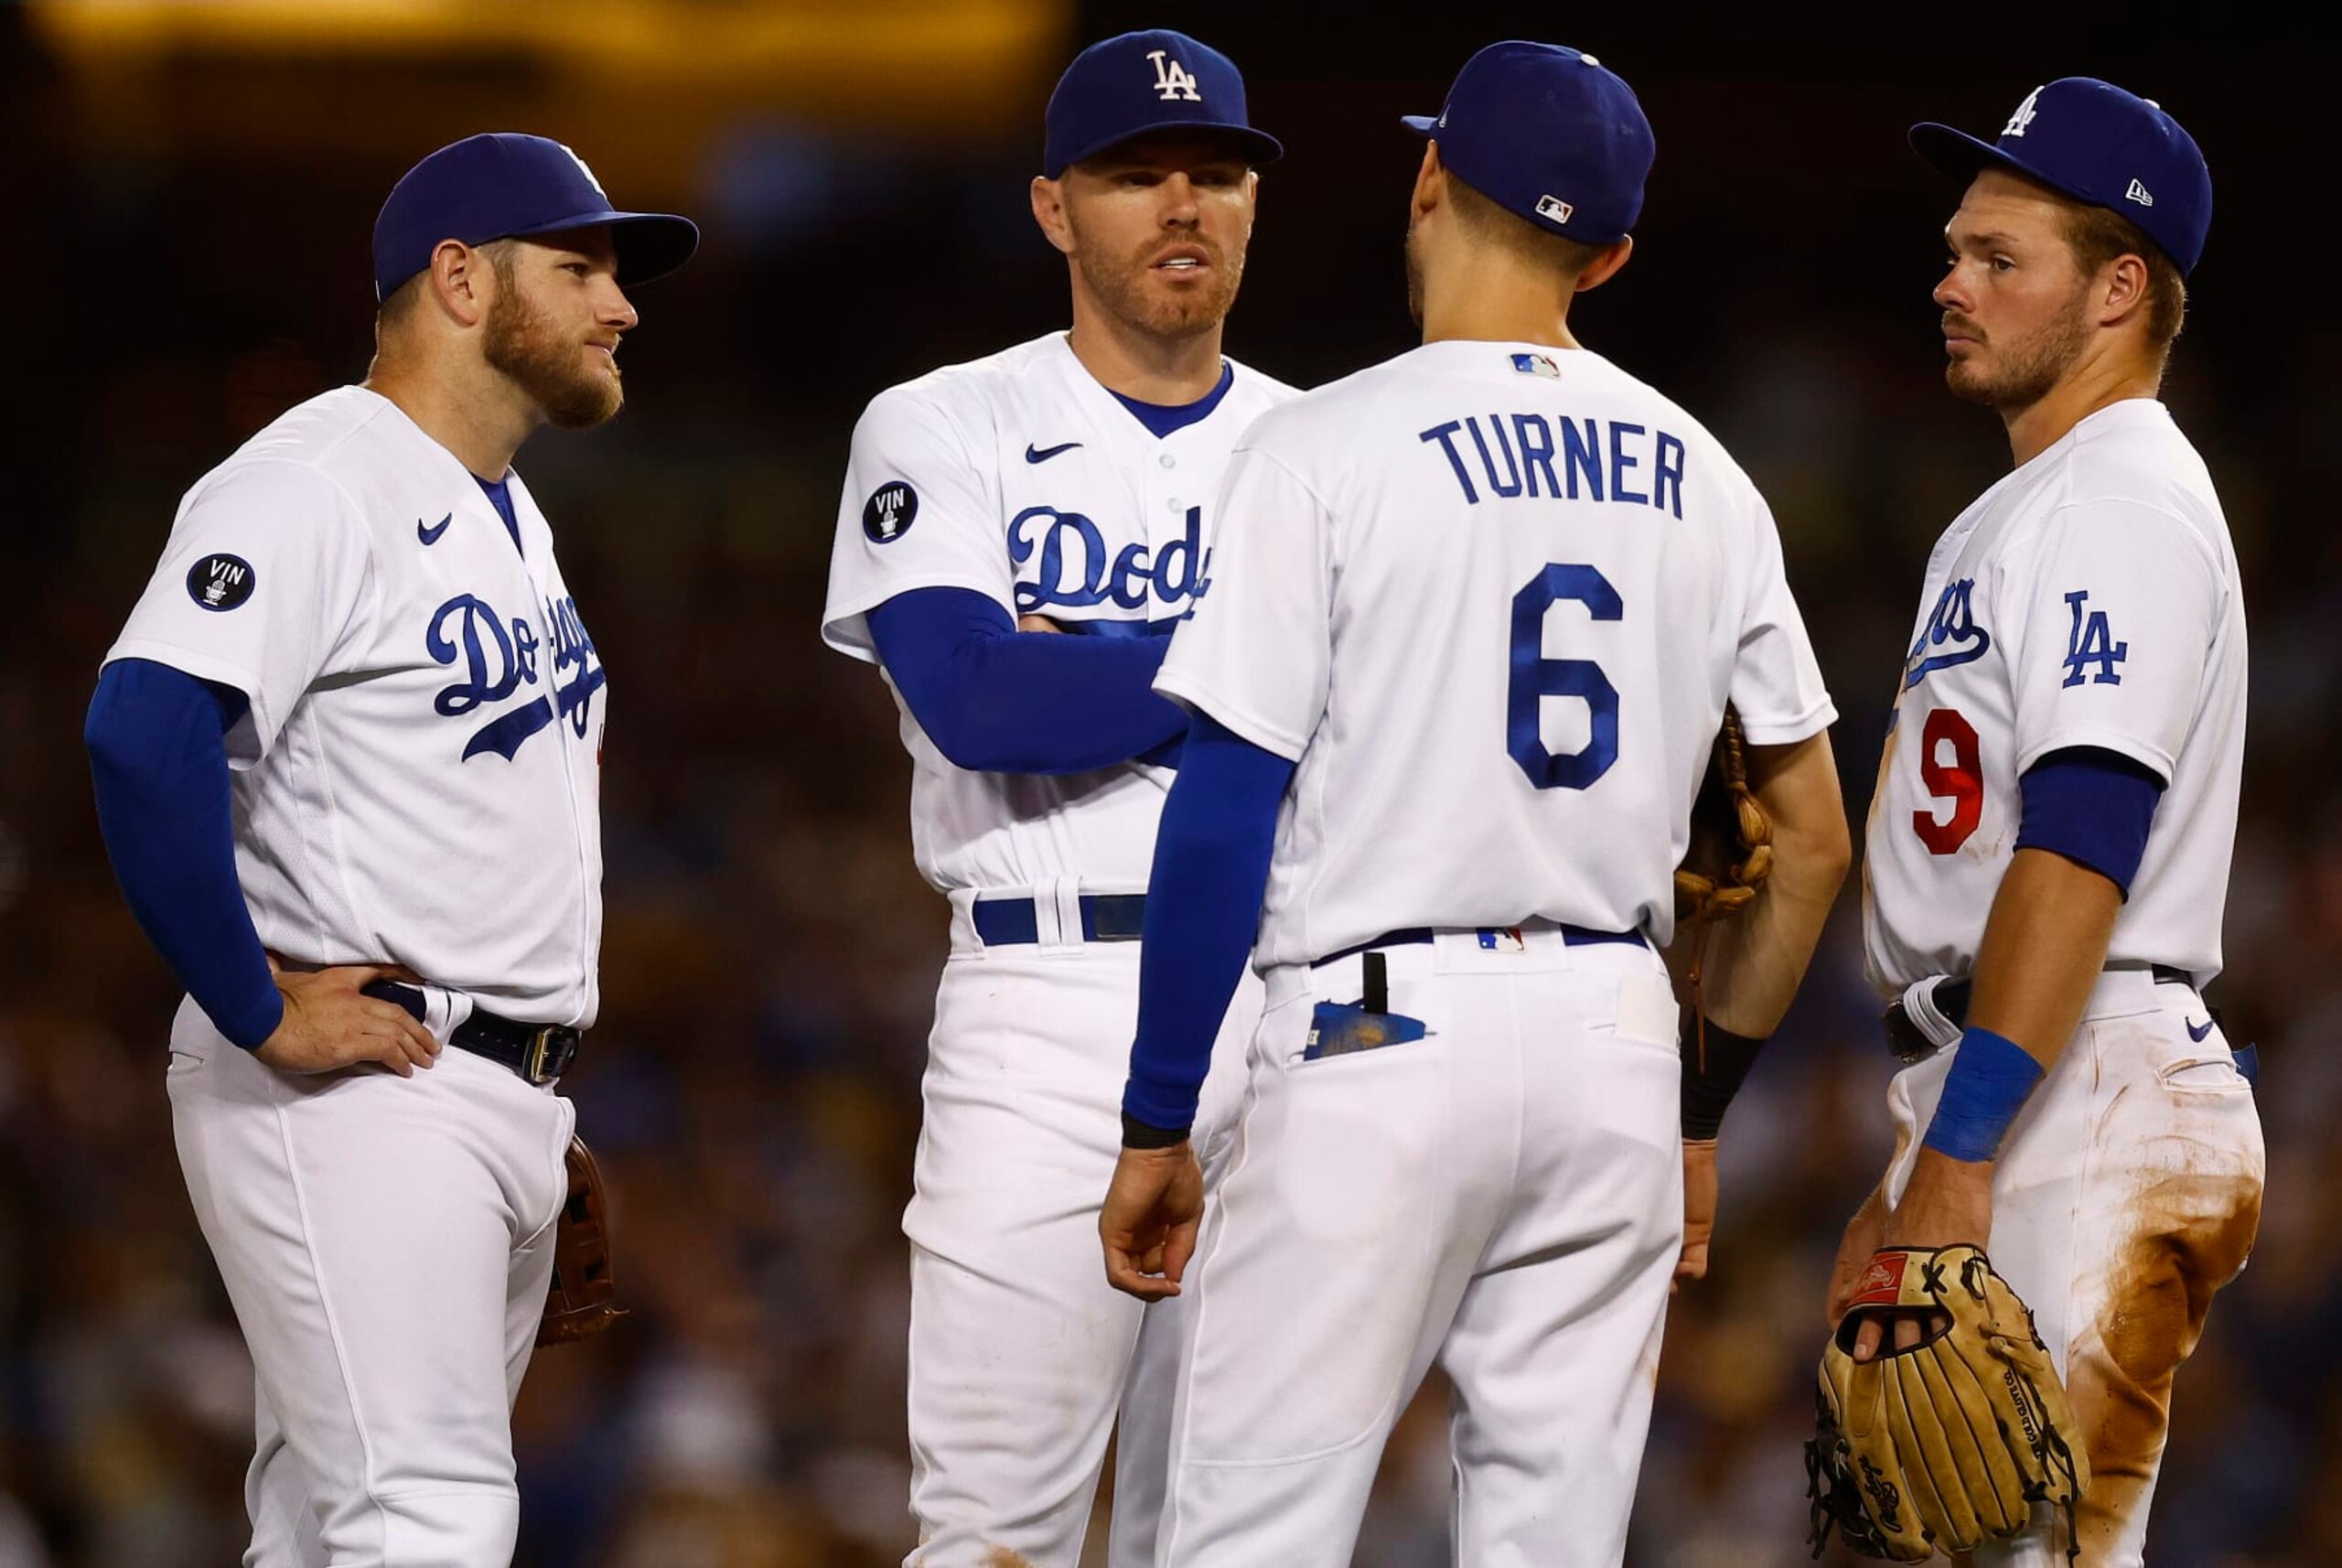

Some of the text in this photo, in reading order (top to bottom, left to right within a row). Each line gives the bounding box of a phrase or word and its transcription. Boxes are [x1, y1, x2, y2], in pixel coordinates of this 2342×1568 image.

[1146, 50, 1201, 102] LA
[876, 489, 904, 514] VIN
[1419, 413, 1685, 521] TURNER
[210, 559, 245, 585] VIN
[1007, 506, 1211, 613] Dod
[1507, 563, 1623, 791] 6
[2062, 590, 2128, 689] LA
[1913, 708, 1983, 854] 9
